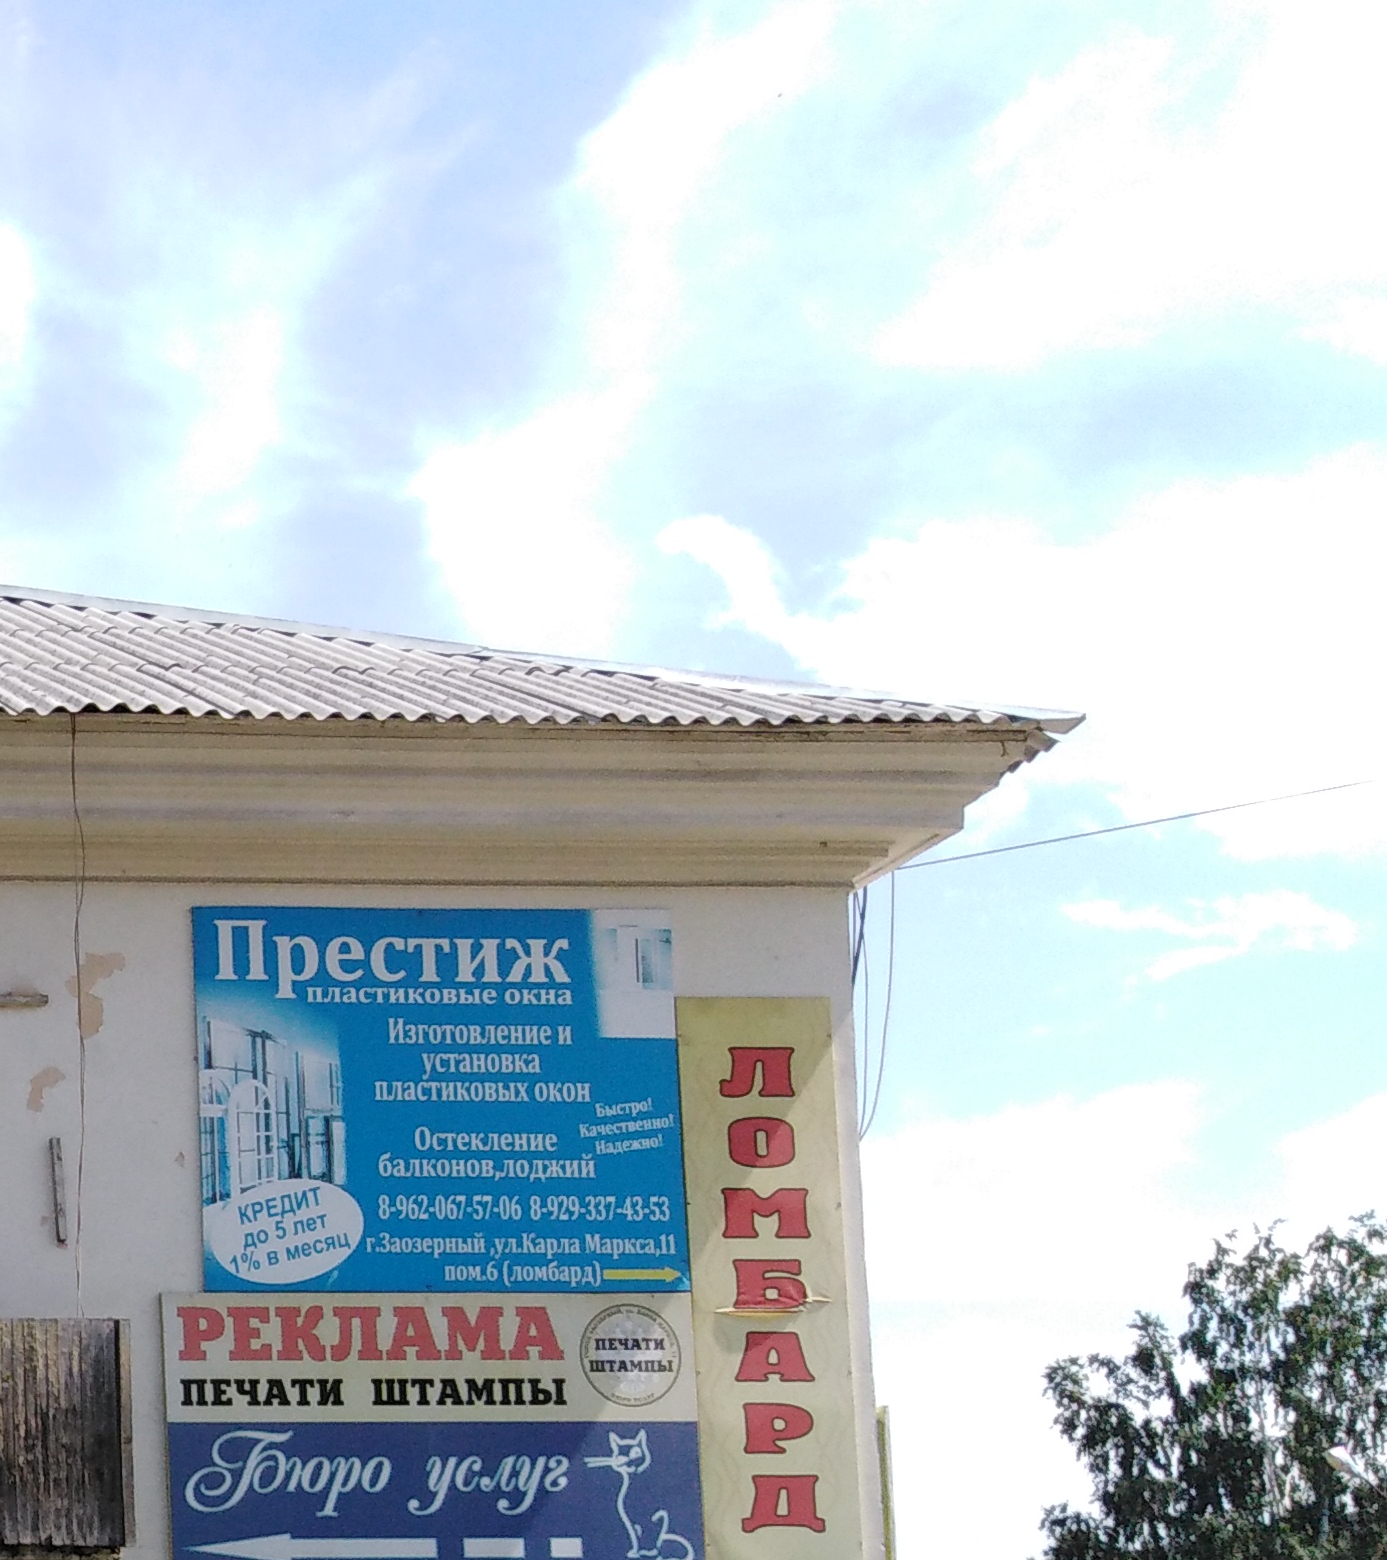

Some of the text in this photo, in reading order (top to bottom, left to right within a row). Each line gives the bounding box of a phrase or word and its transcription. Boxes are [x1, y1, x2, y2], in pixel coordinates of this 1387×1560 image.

[213, 919, 572, 998] Престиж
[306, 985, 574, 1006] пластиковые окна
[388, 1017, 572, 1045] Изготовление и
[421, 1052, 541, 1079] установка
[374, 1080, 592, 1102] пластиковых окон
[594, 1097, 653, 1118] Быстро!
[414, 1126, 558, 1151] Остекление
[578, 1113, 675, 1138] Качественно!
[594, 1133, 665, 1155] Надежно!
[378, 1152, 596, 1182] балконов,лоджий
[237, 1186, 321, 1226] КРЕДИТ
[378, 1194, 670, 1222] 8-962-067-57-06 8-929-337-43-53
[243, 1213, 328, 1251] до 5 лет
[229, 1231, 351, 1274] 1% в месяц
[444, 1260, 603, 1288] пом.6 (ломбард)
[719, 1046, 826, 1534] ЛОМБАРД
[176, 1305, 566, 1362] РЕКЛАМА
[594, 1338, 666, 1351] ПЕЧАТИ
[588, 1359, 674, 1373] ШТАМПЫ
[180, 1378, 568, 1407] ПЕЧАТИ ШТАМПЫ
[184, 1429, 570, 1518] Бюро услуг
